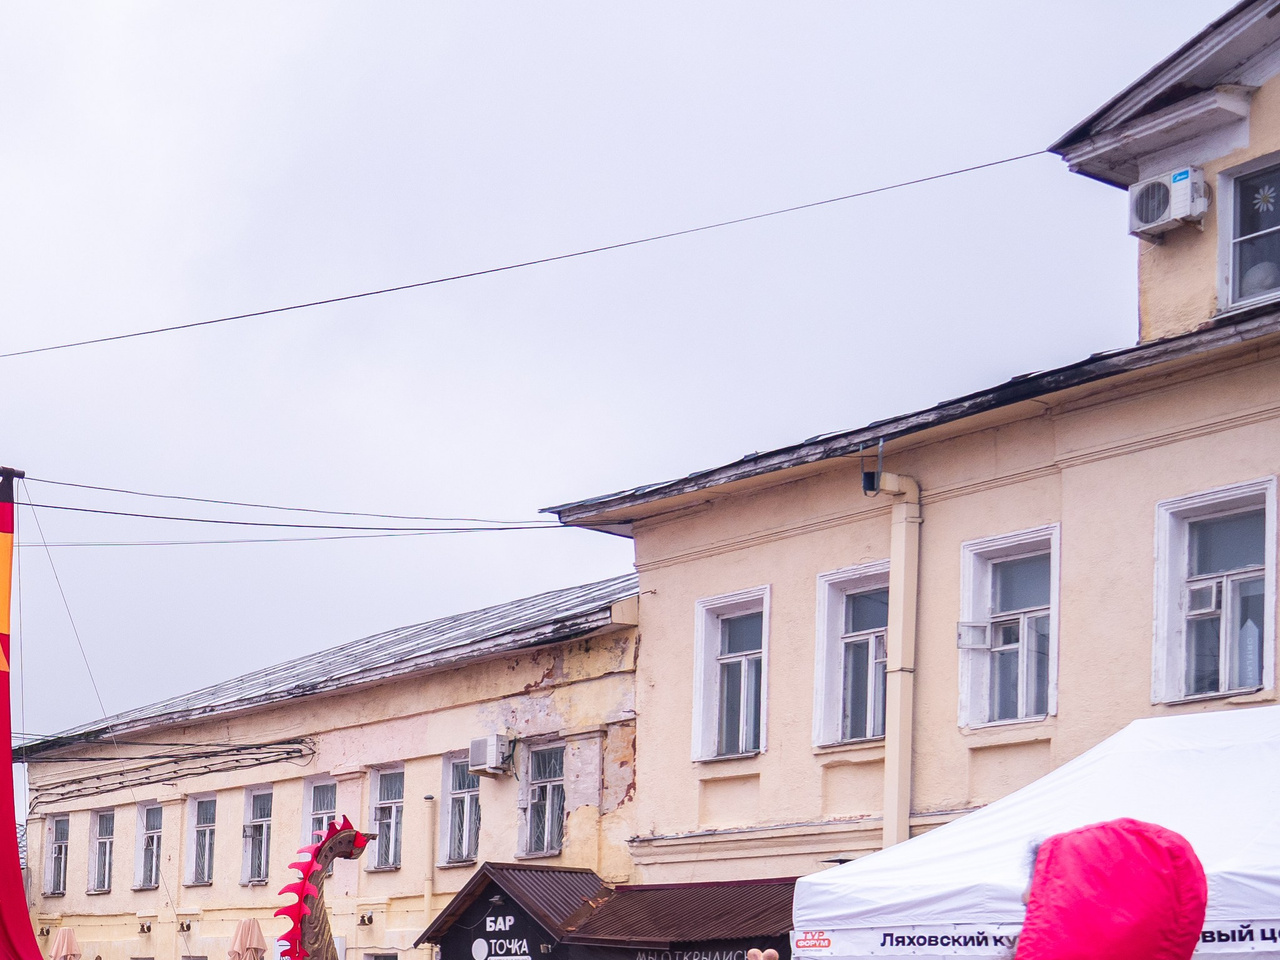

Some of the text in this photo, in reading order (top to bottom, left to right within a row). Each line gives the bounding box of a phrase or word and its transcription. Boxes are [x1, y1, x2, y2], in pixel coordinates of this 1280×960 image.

[486, 916, 515, 931] БАР
[802, 931, 825, 940] ТУР
[880, 931, 989, 947] Ляховский
[489, 938, 529, 955] ТОЧКА
